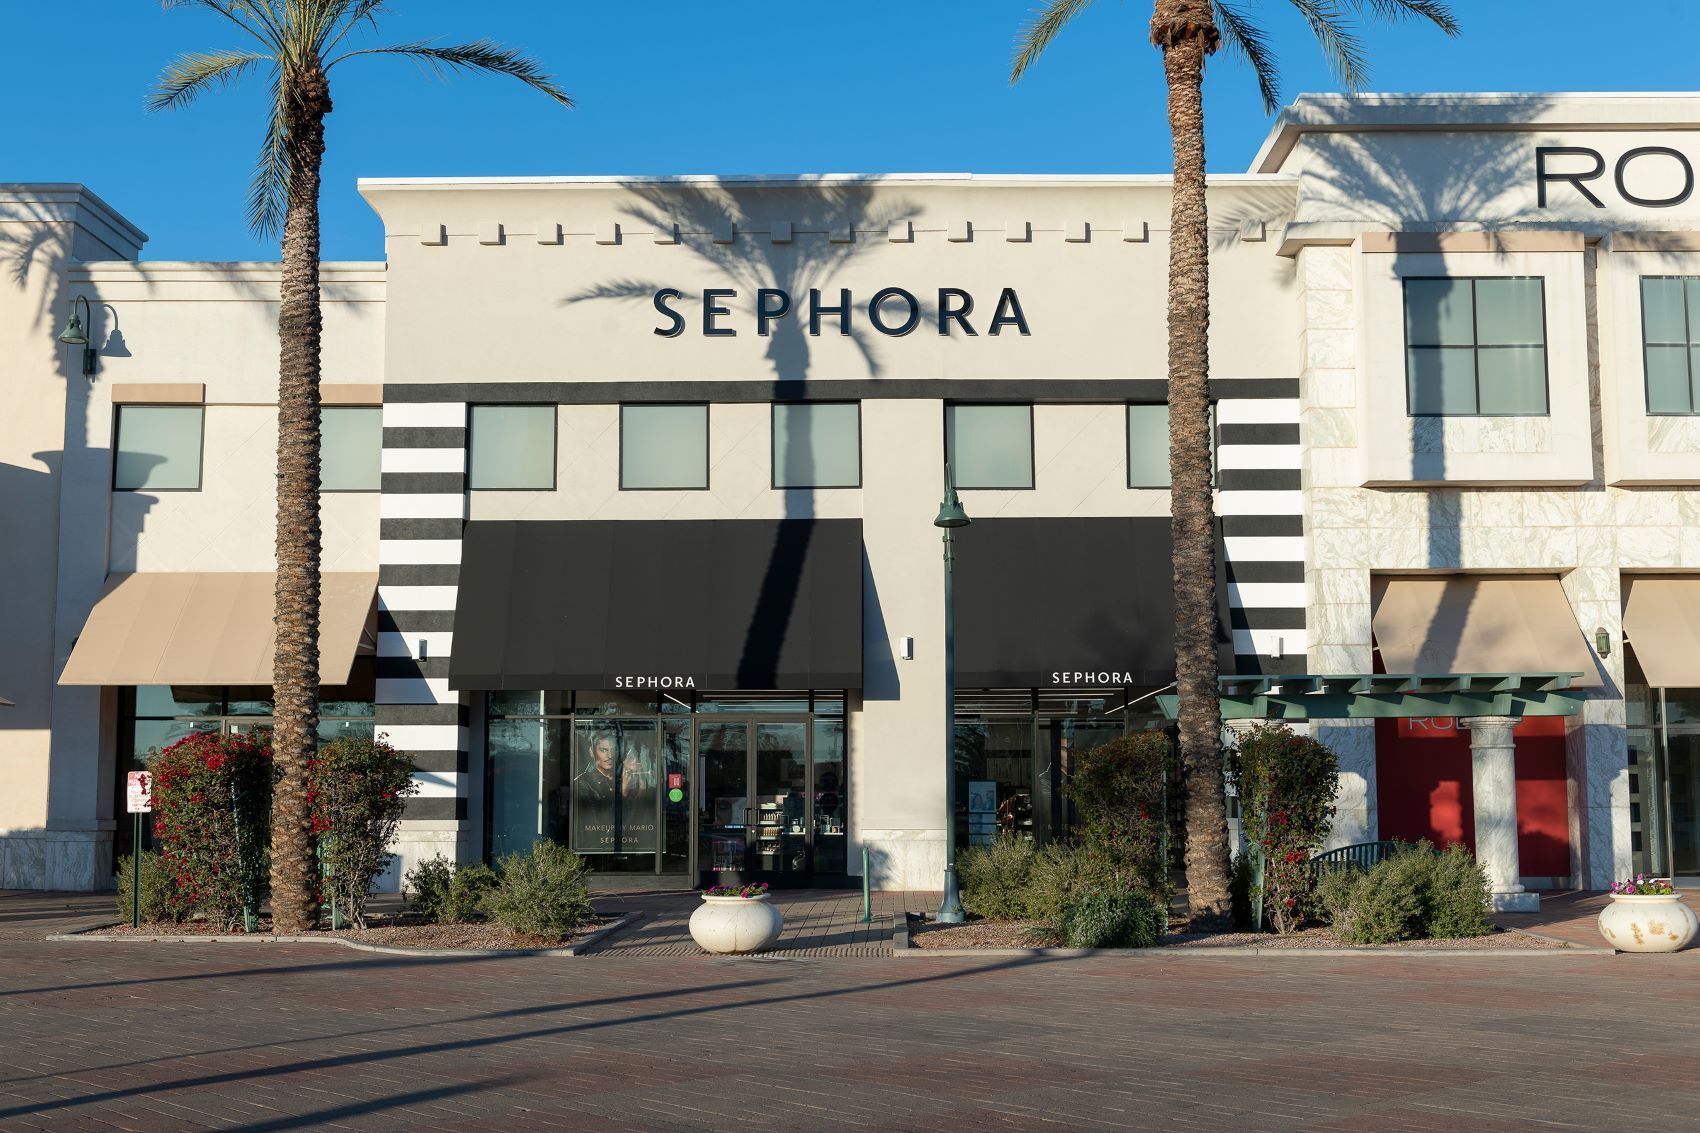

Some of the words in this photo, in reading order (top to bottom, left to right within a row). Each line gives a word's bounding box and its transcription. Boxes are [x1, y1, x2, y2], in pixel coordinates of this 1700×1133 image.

[1536, 146, 1695, 209] RO
[653, 287, 1032, 338] SEPHORA
[615, 676, 695, 688] SEPHORA
[1052, 671, 1133, 684] SEPHORA
[600, 836, 639, 844] SEPORA
